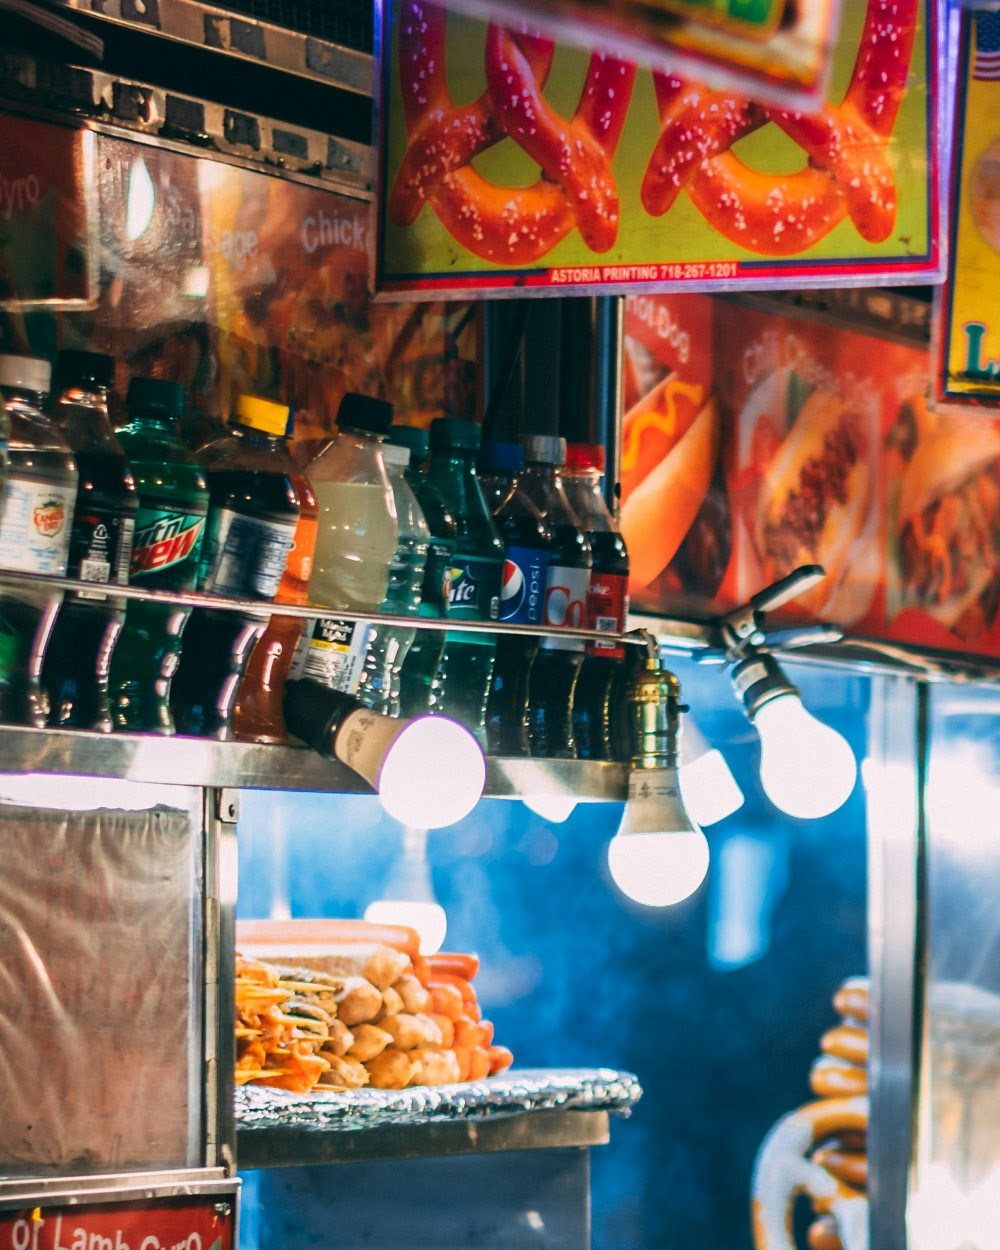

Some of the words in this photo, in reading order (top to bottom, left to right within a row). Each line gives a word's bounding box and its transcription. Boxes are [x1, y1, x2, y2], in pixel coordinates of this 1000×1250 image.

[0, 174, 39, 219] yro
[550, 268, 601, 283] ASTORIA
[603, 266, 658, 281] PRINTING
[660, 263, 737, 279] 718-267-1201
[658, 305, 690, 364] Dog
[527, 563, 541, 621] pepsi
